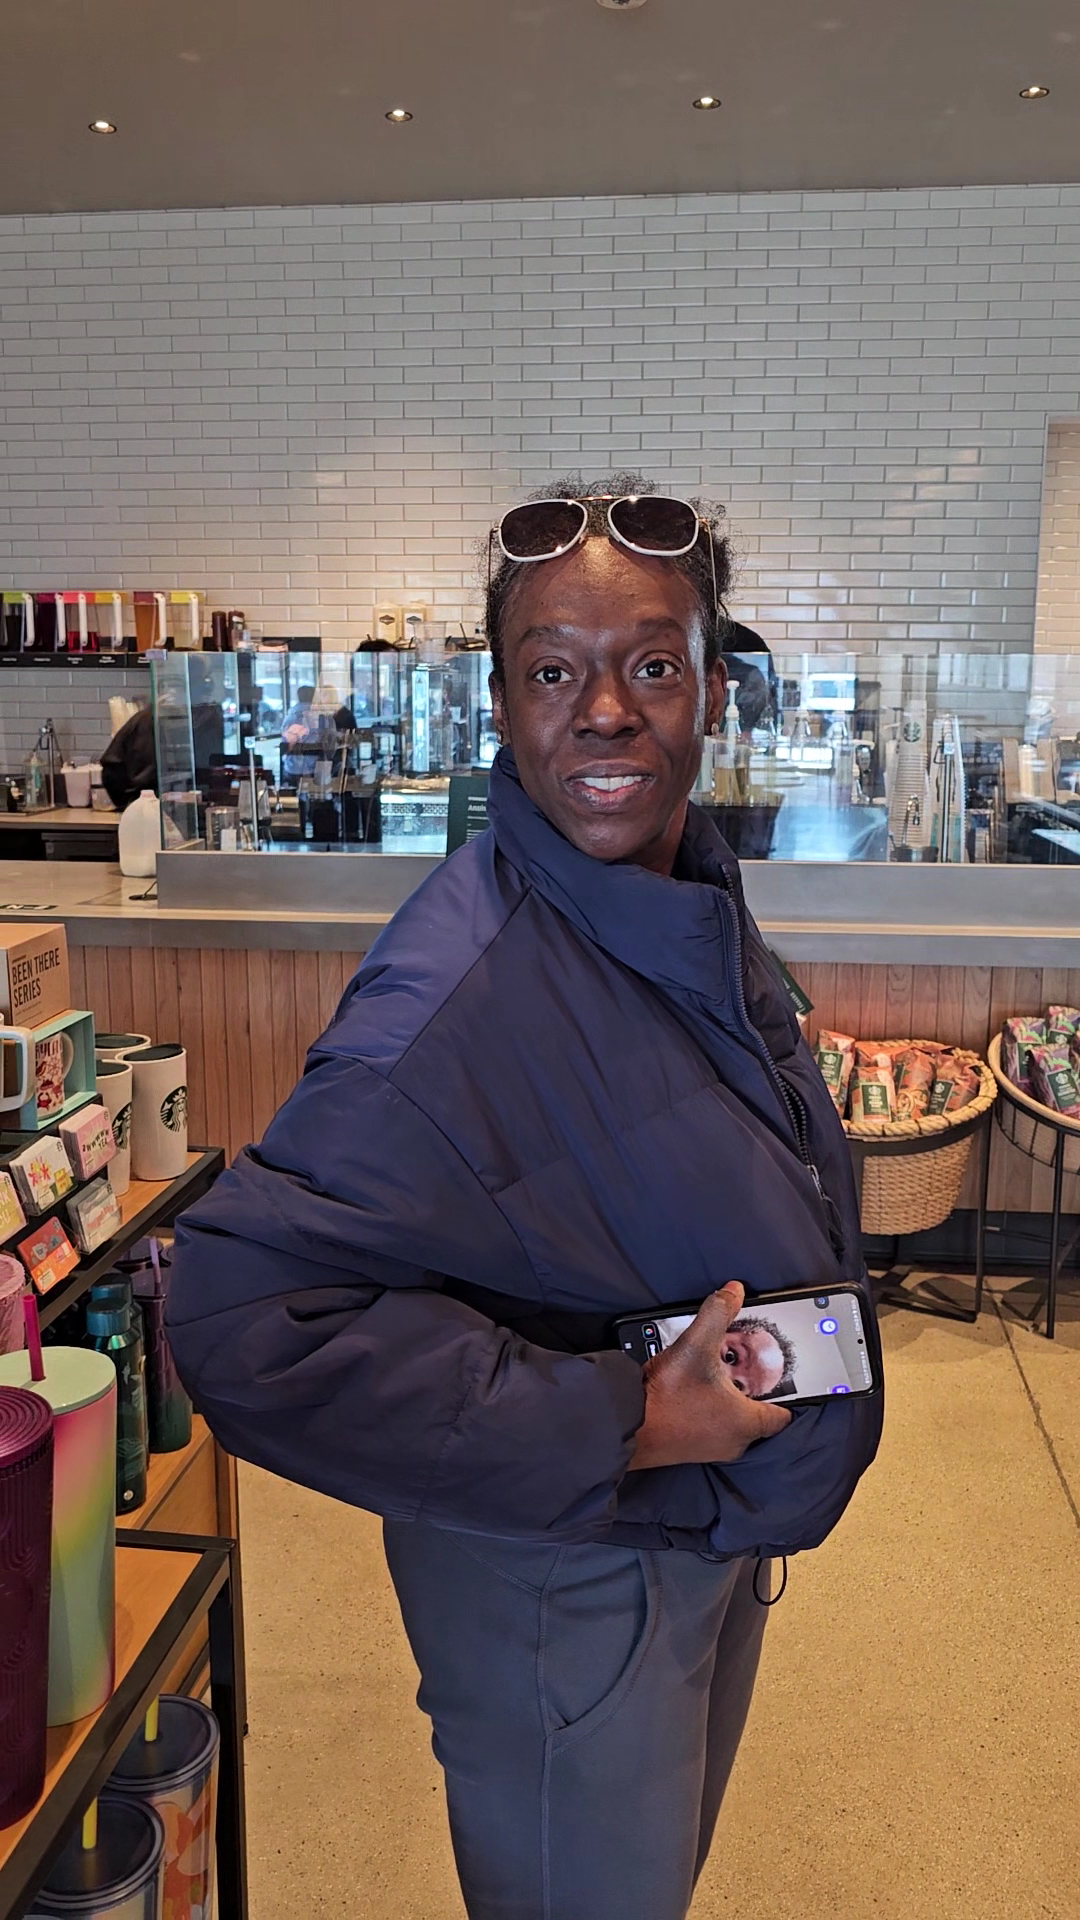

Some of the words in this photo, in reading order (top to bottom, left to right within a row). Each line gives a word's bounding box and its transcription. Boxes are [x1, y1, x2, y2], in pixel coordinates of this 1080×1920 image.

[12, 959, 33, 986] BEEN
[34, 948, 60, 974] THERE
[13, 978, 42, 1008] SERIES
